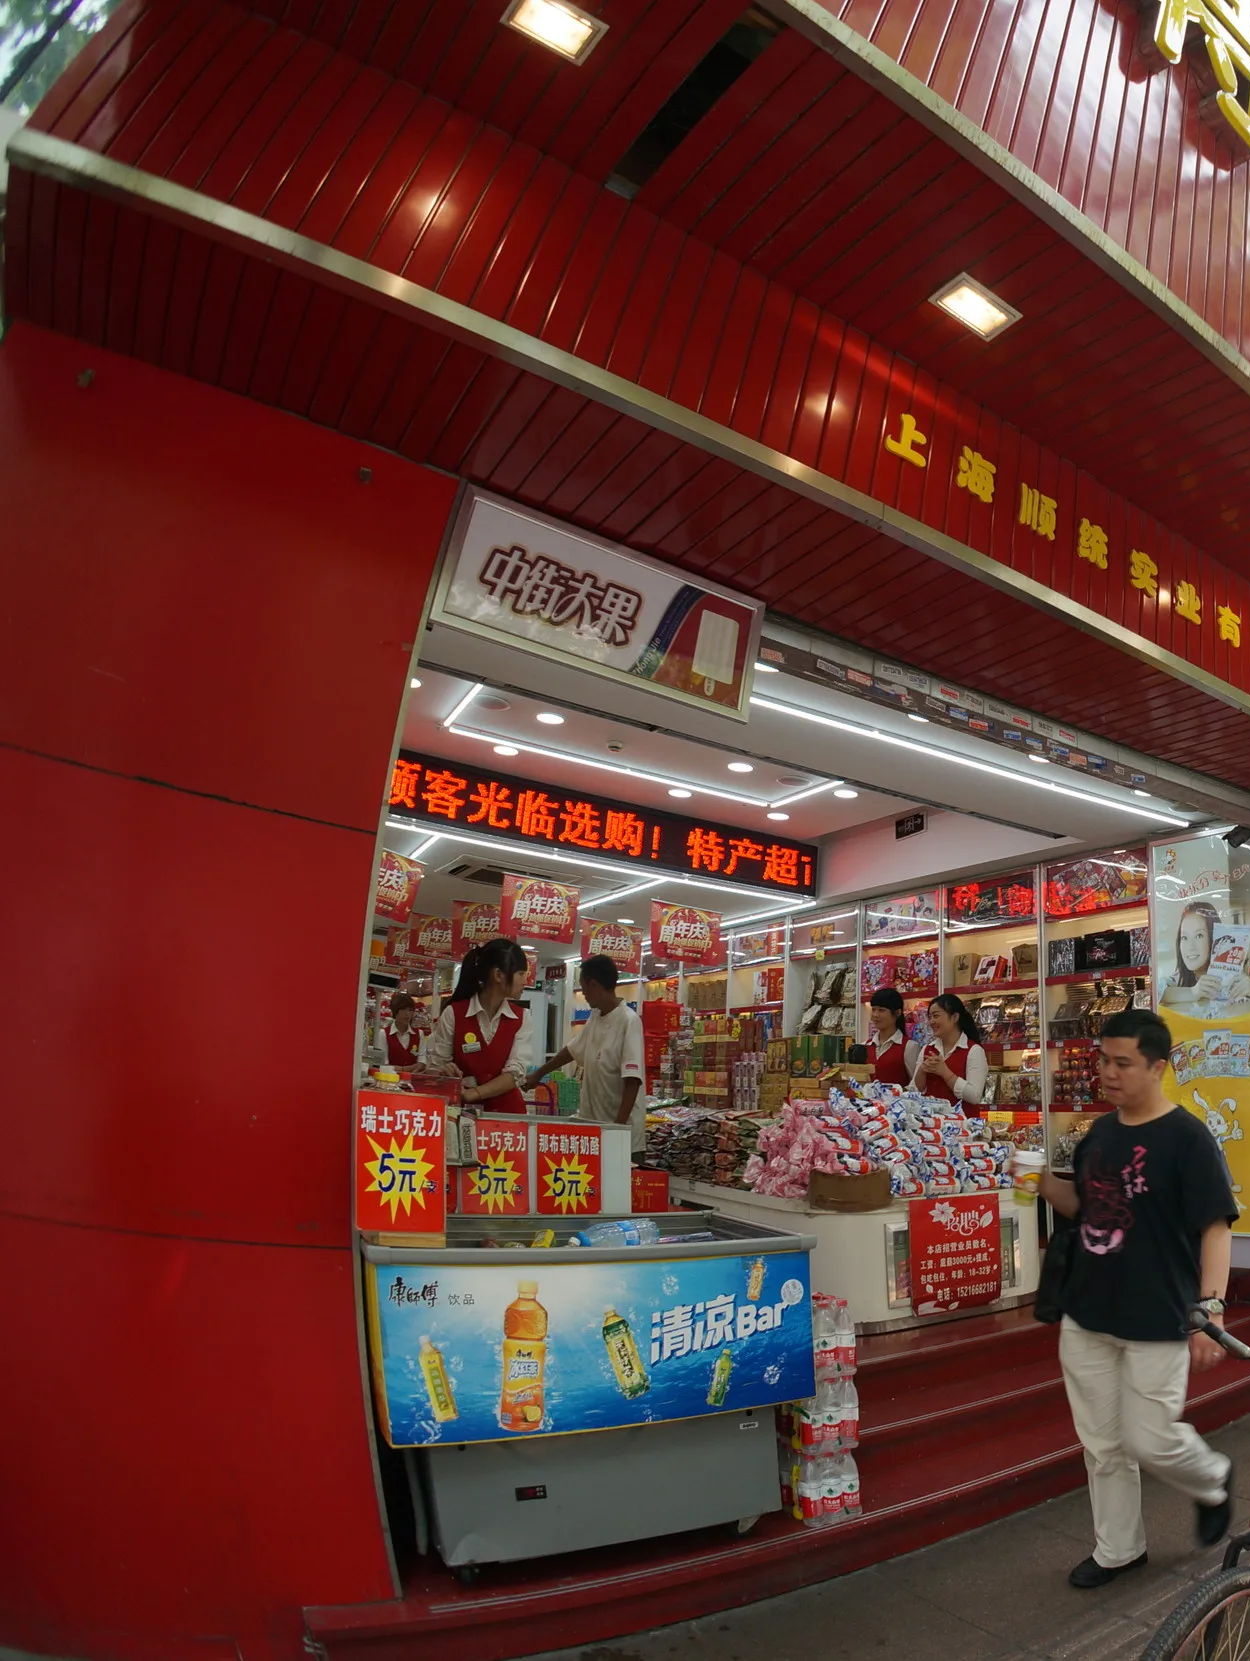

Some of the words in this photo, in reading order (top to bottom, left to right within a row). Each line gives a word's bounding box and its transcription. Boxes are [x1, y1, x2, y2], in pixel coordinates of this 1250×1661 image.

[478, 545, 642, 648] 中街大果
[360, 1104, 442, 1138] 瑞士巧克力
[476, 1129, 527, 1153] 士巧克力
[538, 1133, 600, 1156] 那布勒斯奶酪
[944, 1210, 981, 1236] 招聘
[447, 1293, 475, 1306] 饮品
